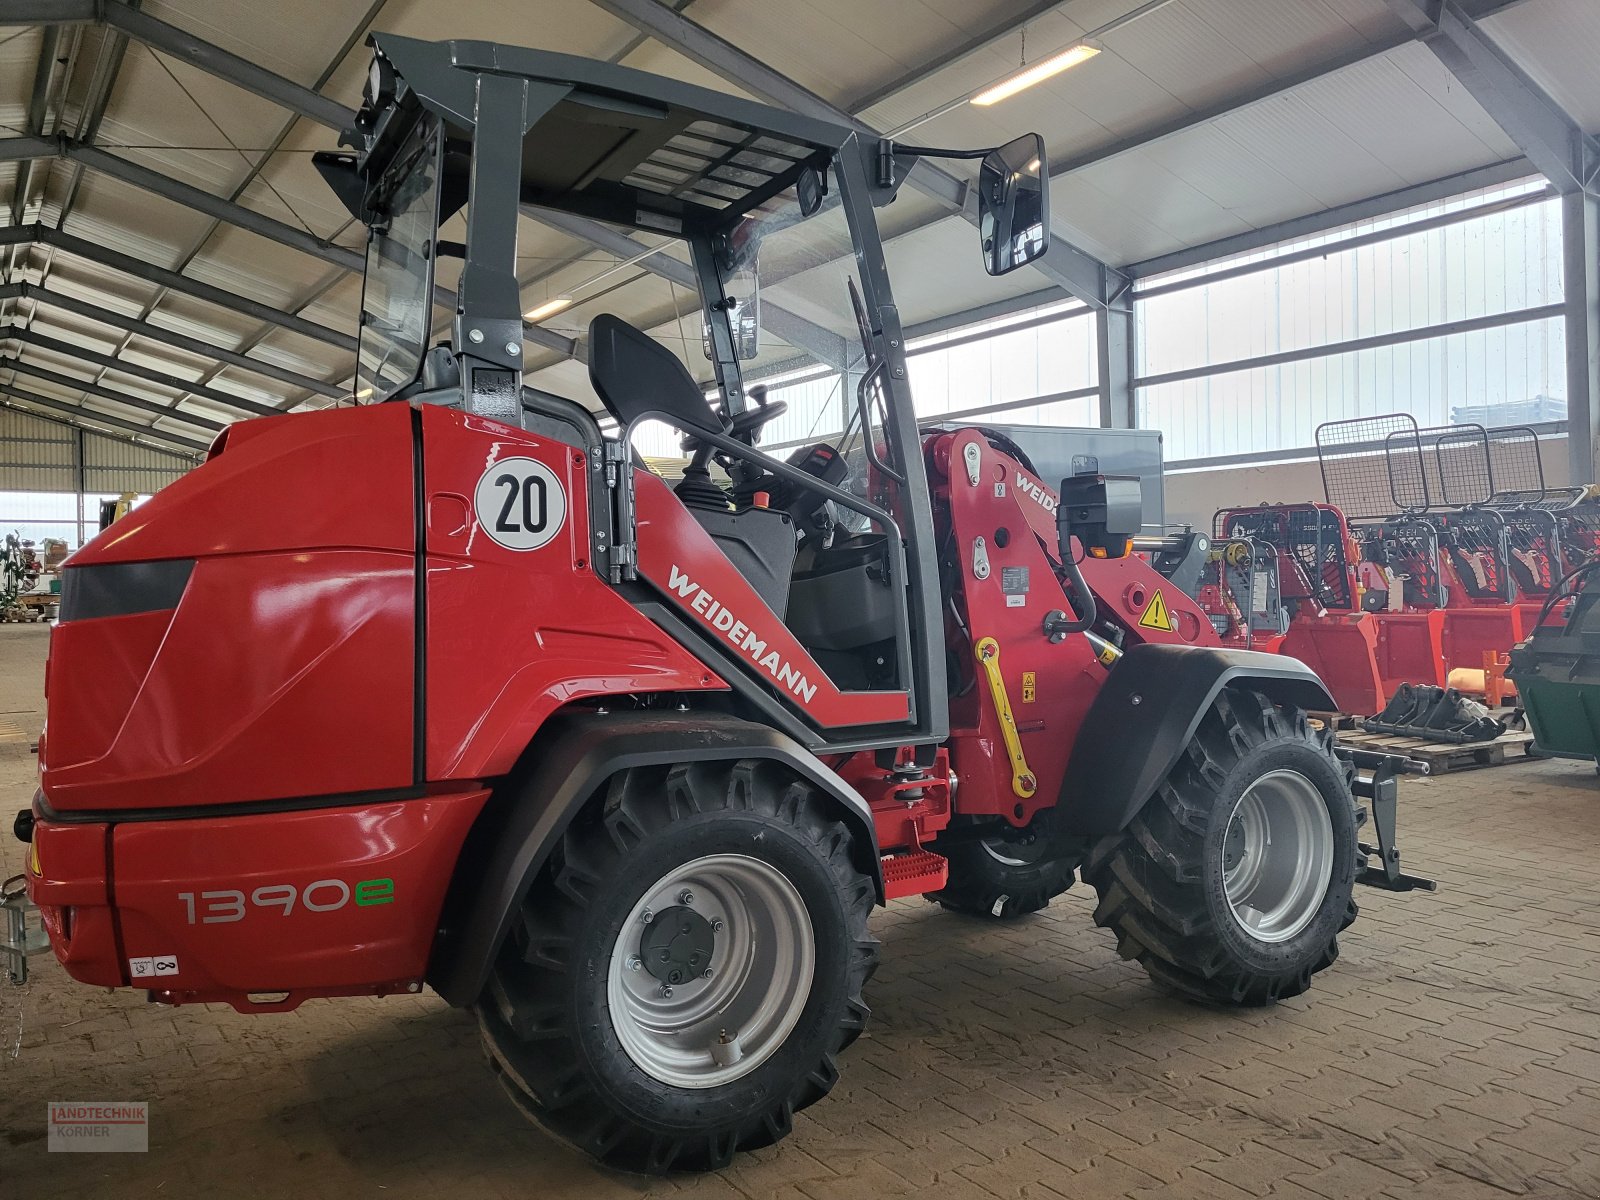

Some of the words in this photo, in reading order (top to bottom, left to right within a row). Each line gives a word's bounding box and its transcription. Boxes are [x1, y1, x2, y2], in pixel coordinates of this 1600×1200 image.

[495, 473, 547, 533] 20
[667, 564, 818, 704] WEIDEMANN
[178, 878, 395, 925] 1390e
